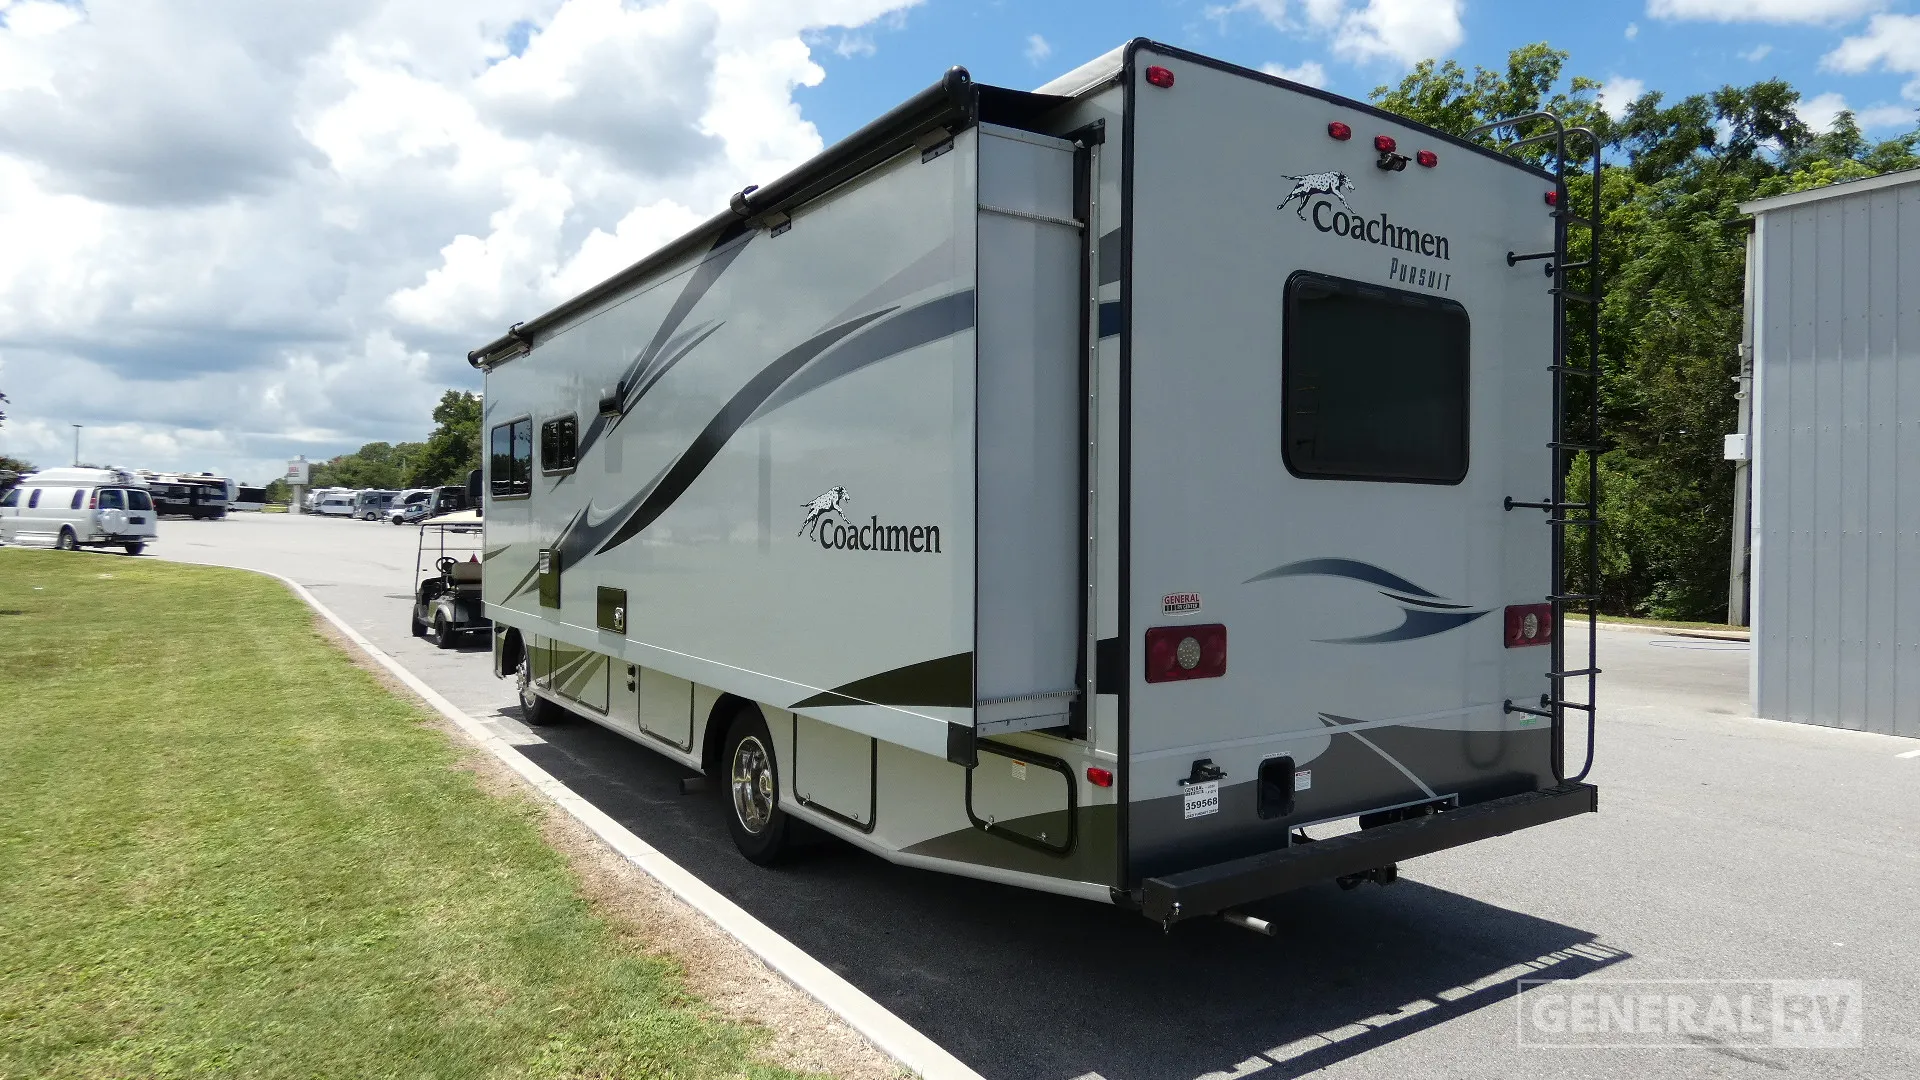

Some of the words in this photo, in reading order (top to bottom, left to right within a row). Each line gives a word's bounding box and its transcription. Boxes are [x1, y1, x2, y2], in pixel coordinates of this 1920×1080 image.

[1312, 200, 1450, 260] Coachmen
[1389, 257, 1451, 291] PURSUIT
[820, 515, 941, 553] Coachmen
[1164, 593, 1199, 604] GENERAL
[1185, 797, 1217, 810] 359568
